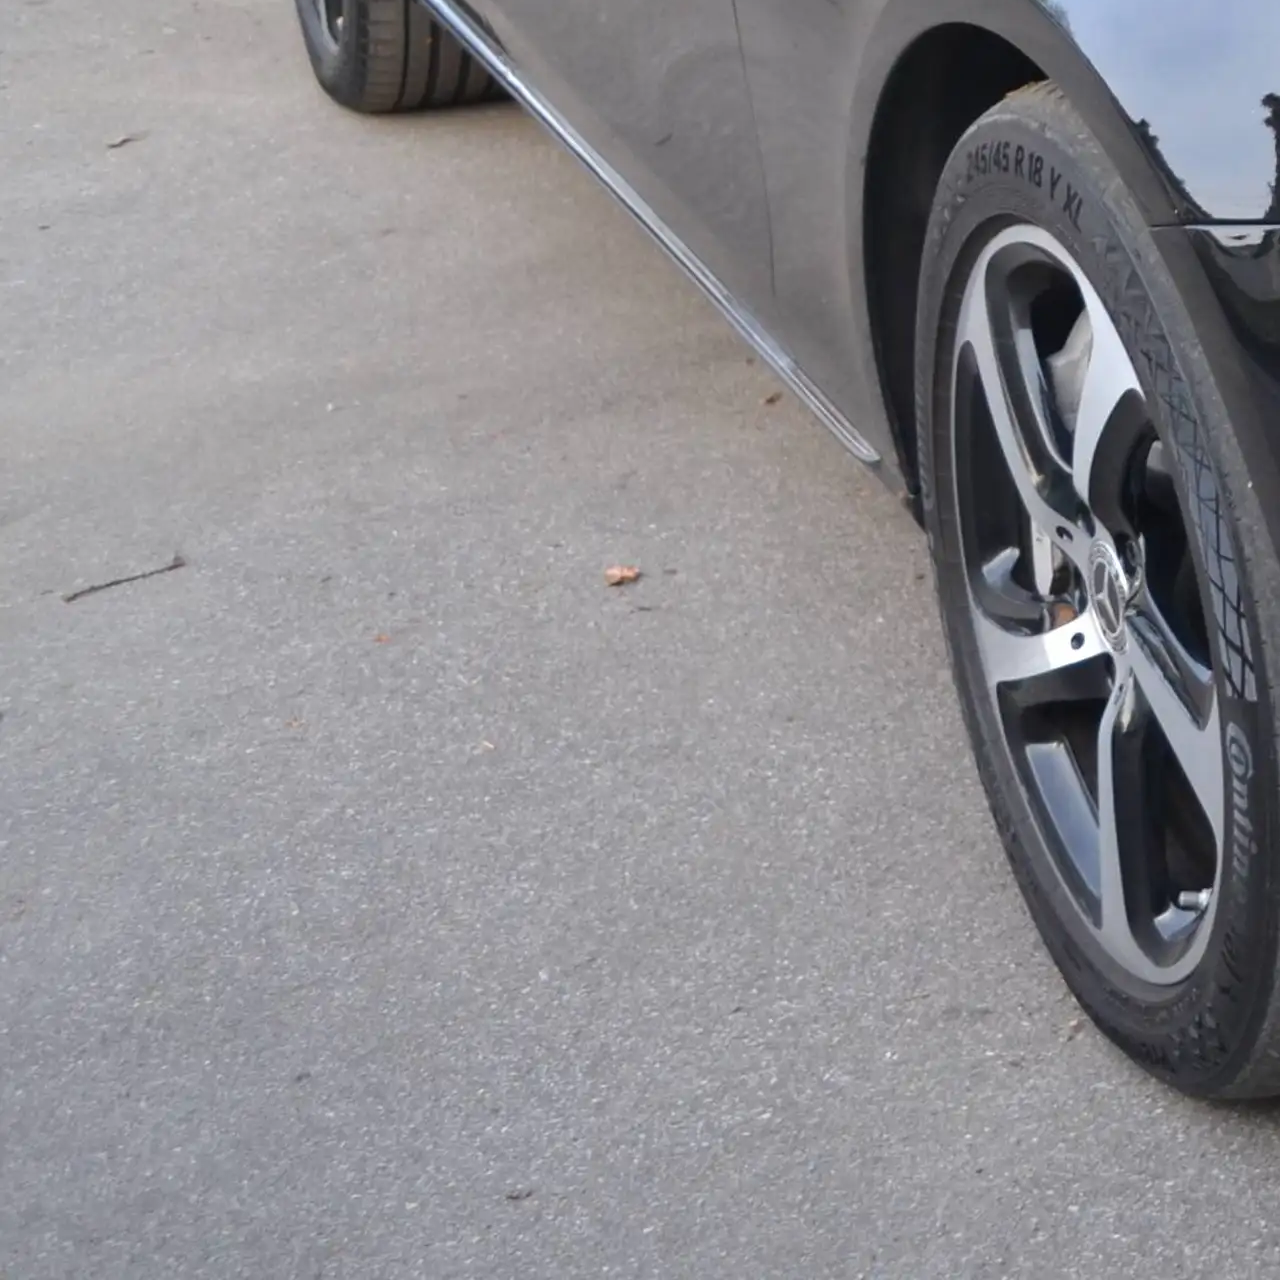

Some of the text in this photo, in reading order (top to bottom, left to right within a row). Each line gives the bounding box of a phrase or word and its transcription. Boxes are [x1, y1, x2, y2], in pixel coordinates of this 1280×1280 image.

[1015, 144, 1025, 180] R
[1028, 151, 1043, 187] 18
[1063, 181, 1083, 234] XL
